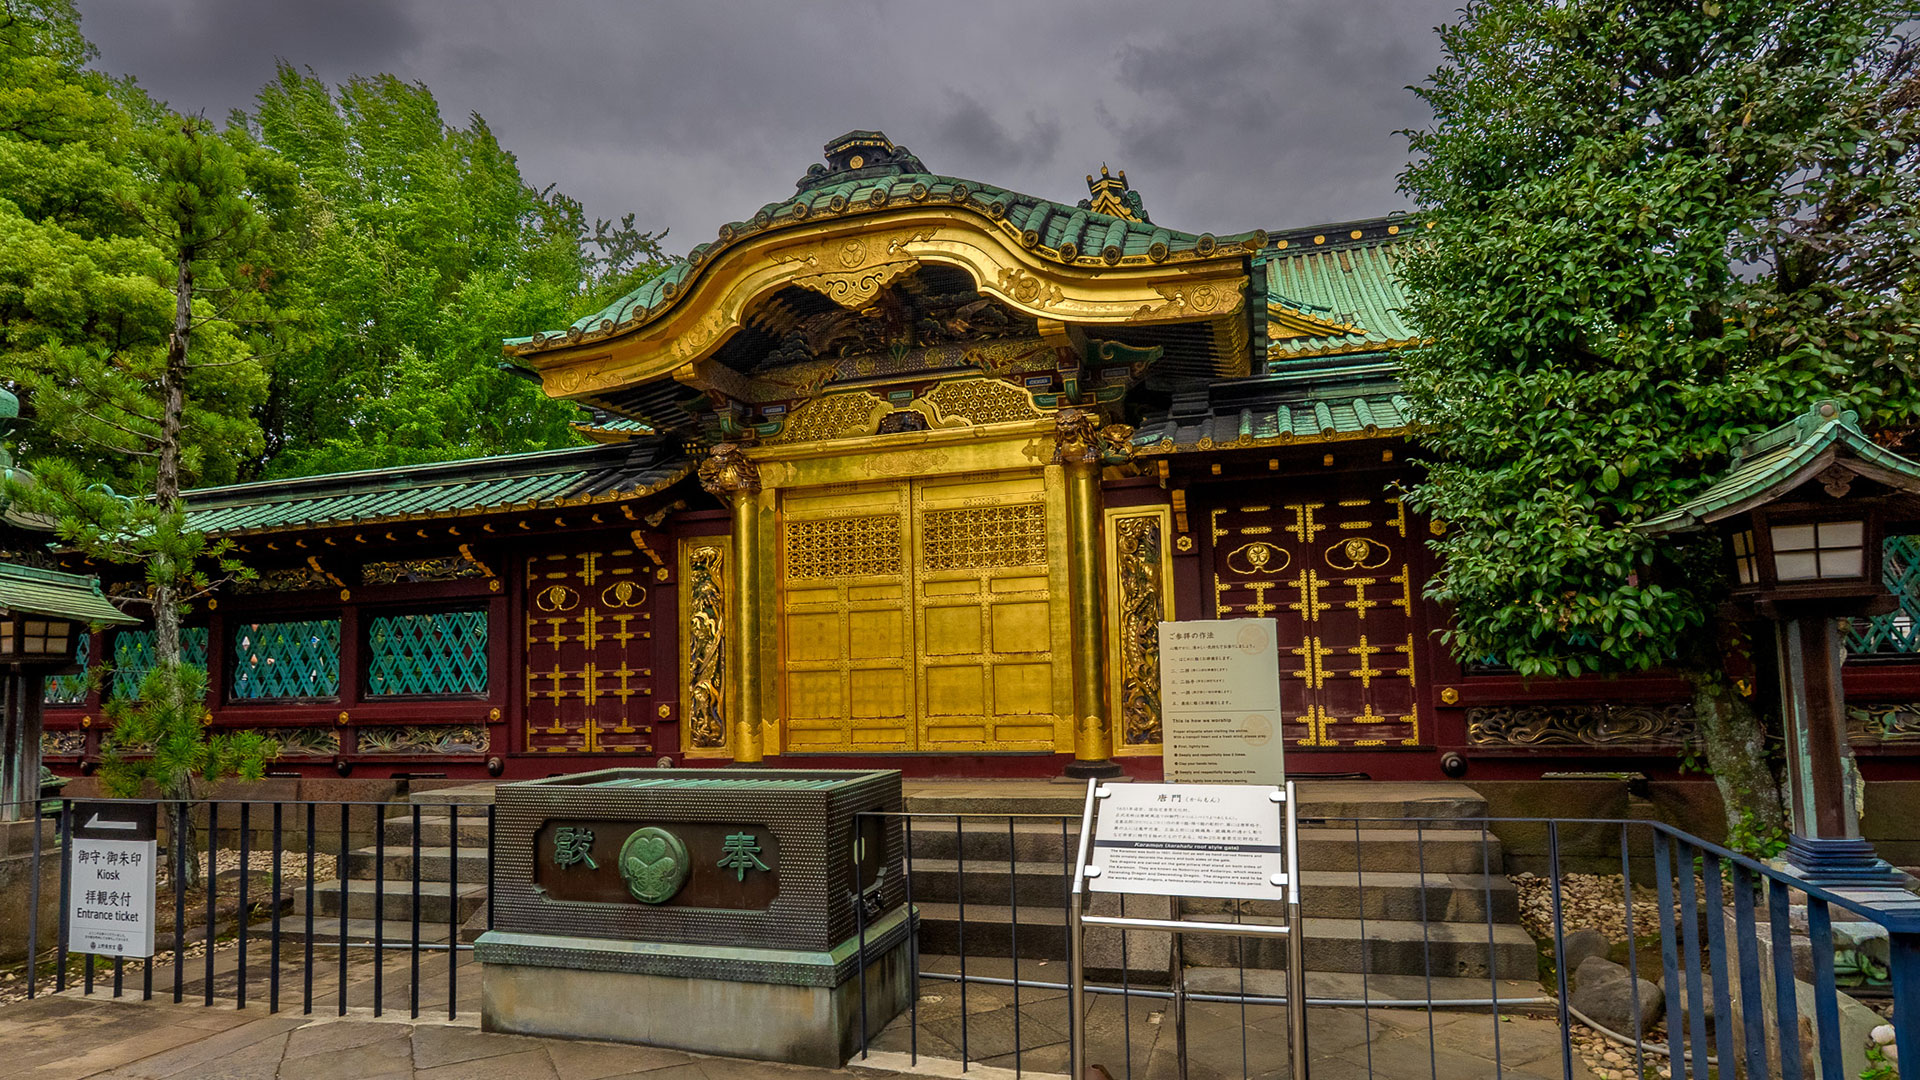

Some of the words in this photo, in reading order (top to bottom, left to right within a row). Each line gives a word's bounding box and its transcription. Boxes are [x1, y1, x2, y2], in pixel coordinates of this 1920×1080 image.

[716, 831, 771, 882] 奉
[97, 869, 120, 880] Kiosk
[85, 890, 132, 907] 拝観受付
[77, 908, 113, 920] Entrance
[115, 911, 139, 922] ticket
